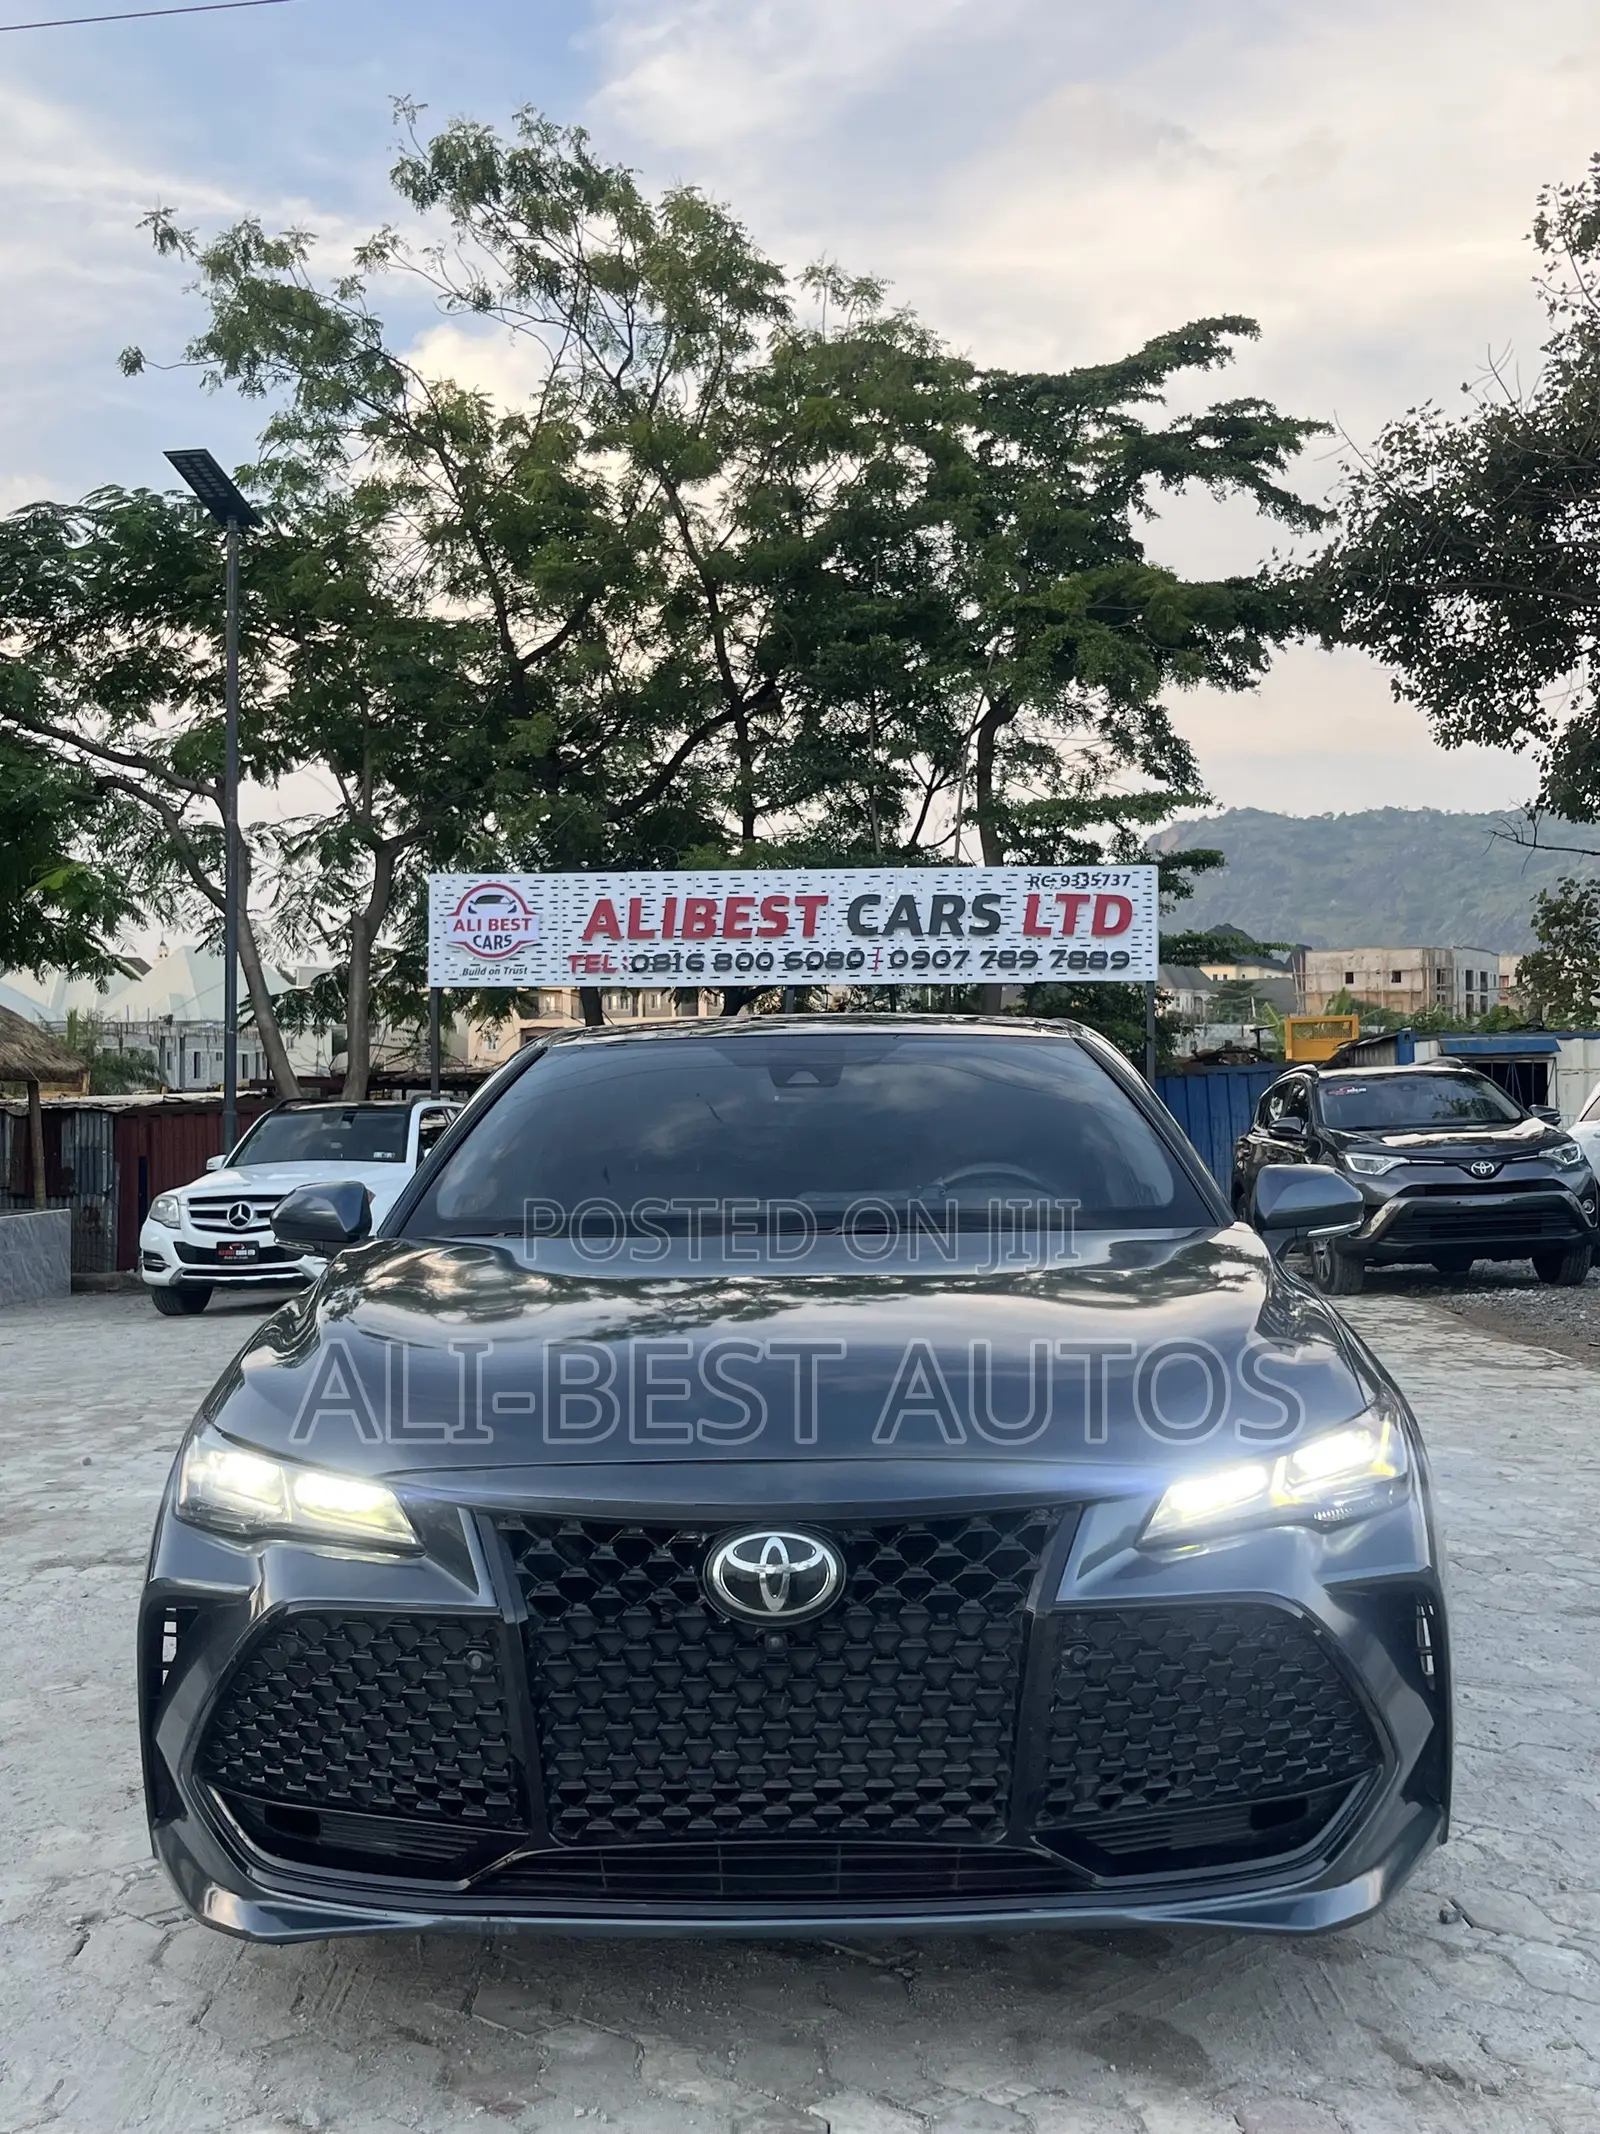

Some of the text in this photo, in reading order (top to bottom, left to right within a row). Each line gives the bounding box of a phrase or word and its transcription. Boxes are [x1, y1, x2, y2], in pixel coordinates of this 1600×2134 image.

[453, 917, 532, 932] ALI BEST
[581, 893, 1133, 941] ALIBEST CARS LTD
[473, 934, 513, 950] CARS
[713, 952, 775, 972] 800
[784, 950, 865, 971] 6080
[890, 950, 970, 970] 0907
[979, 950, 1039, 970] 789
[1049, 950, 1130, 970] 7889
[462, 966, 528, 976] Build on Trust
